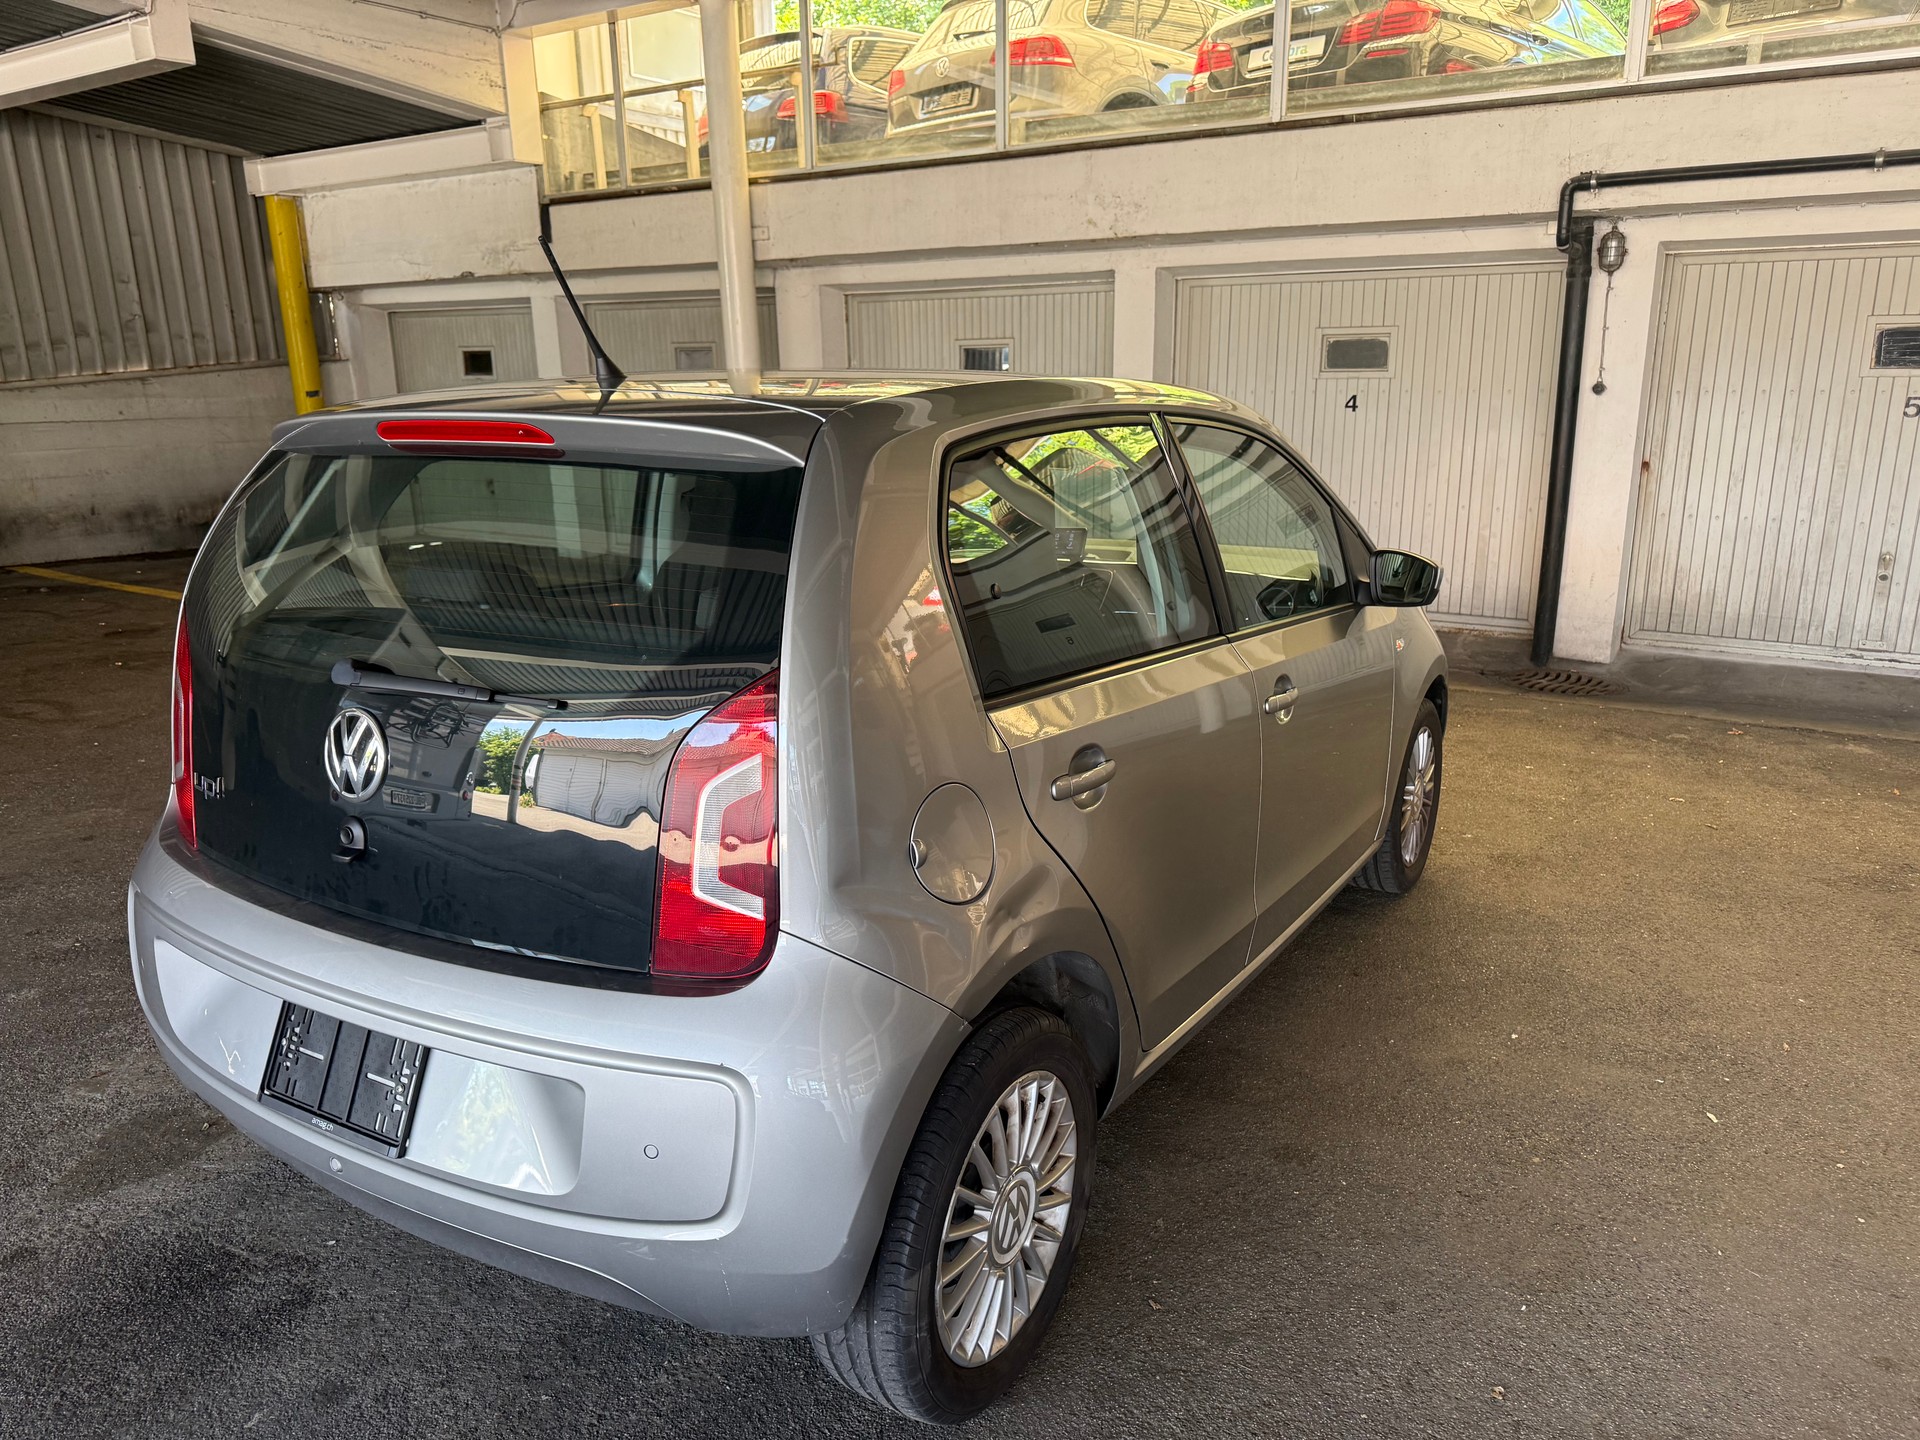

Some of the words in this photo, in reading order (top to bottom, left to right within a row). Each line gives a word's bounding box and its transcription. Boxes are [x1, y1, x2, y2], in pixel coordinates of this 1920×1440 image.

[1344, 394, 1359, 412] 4
[1903, 396, 1920, 418] 5
[312, 1117, 333, 1131] amag.ch
